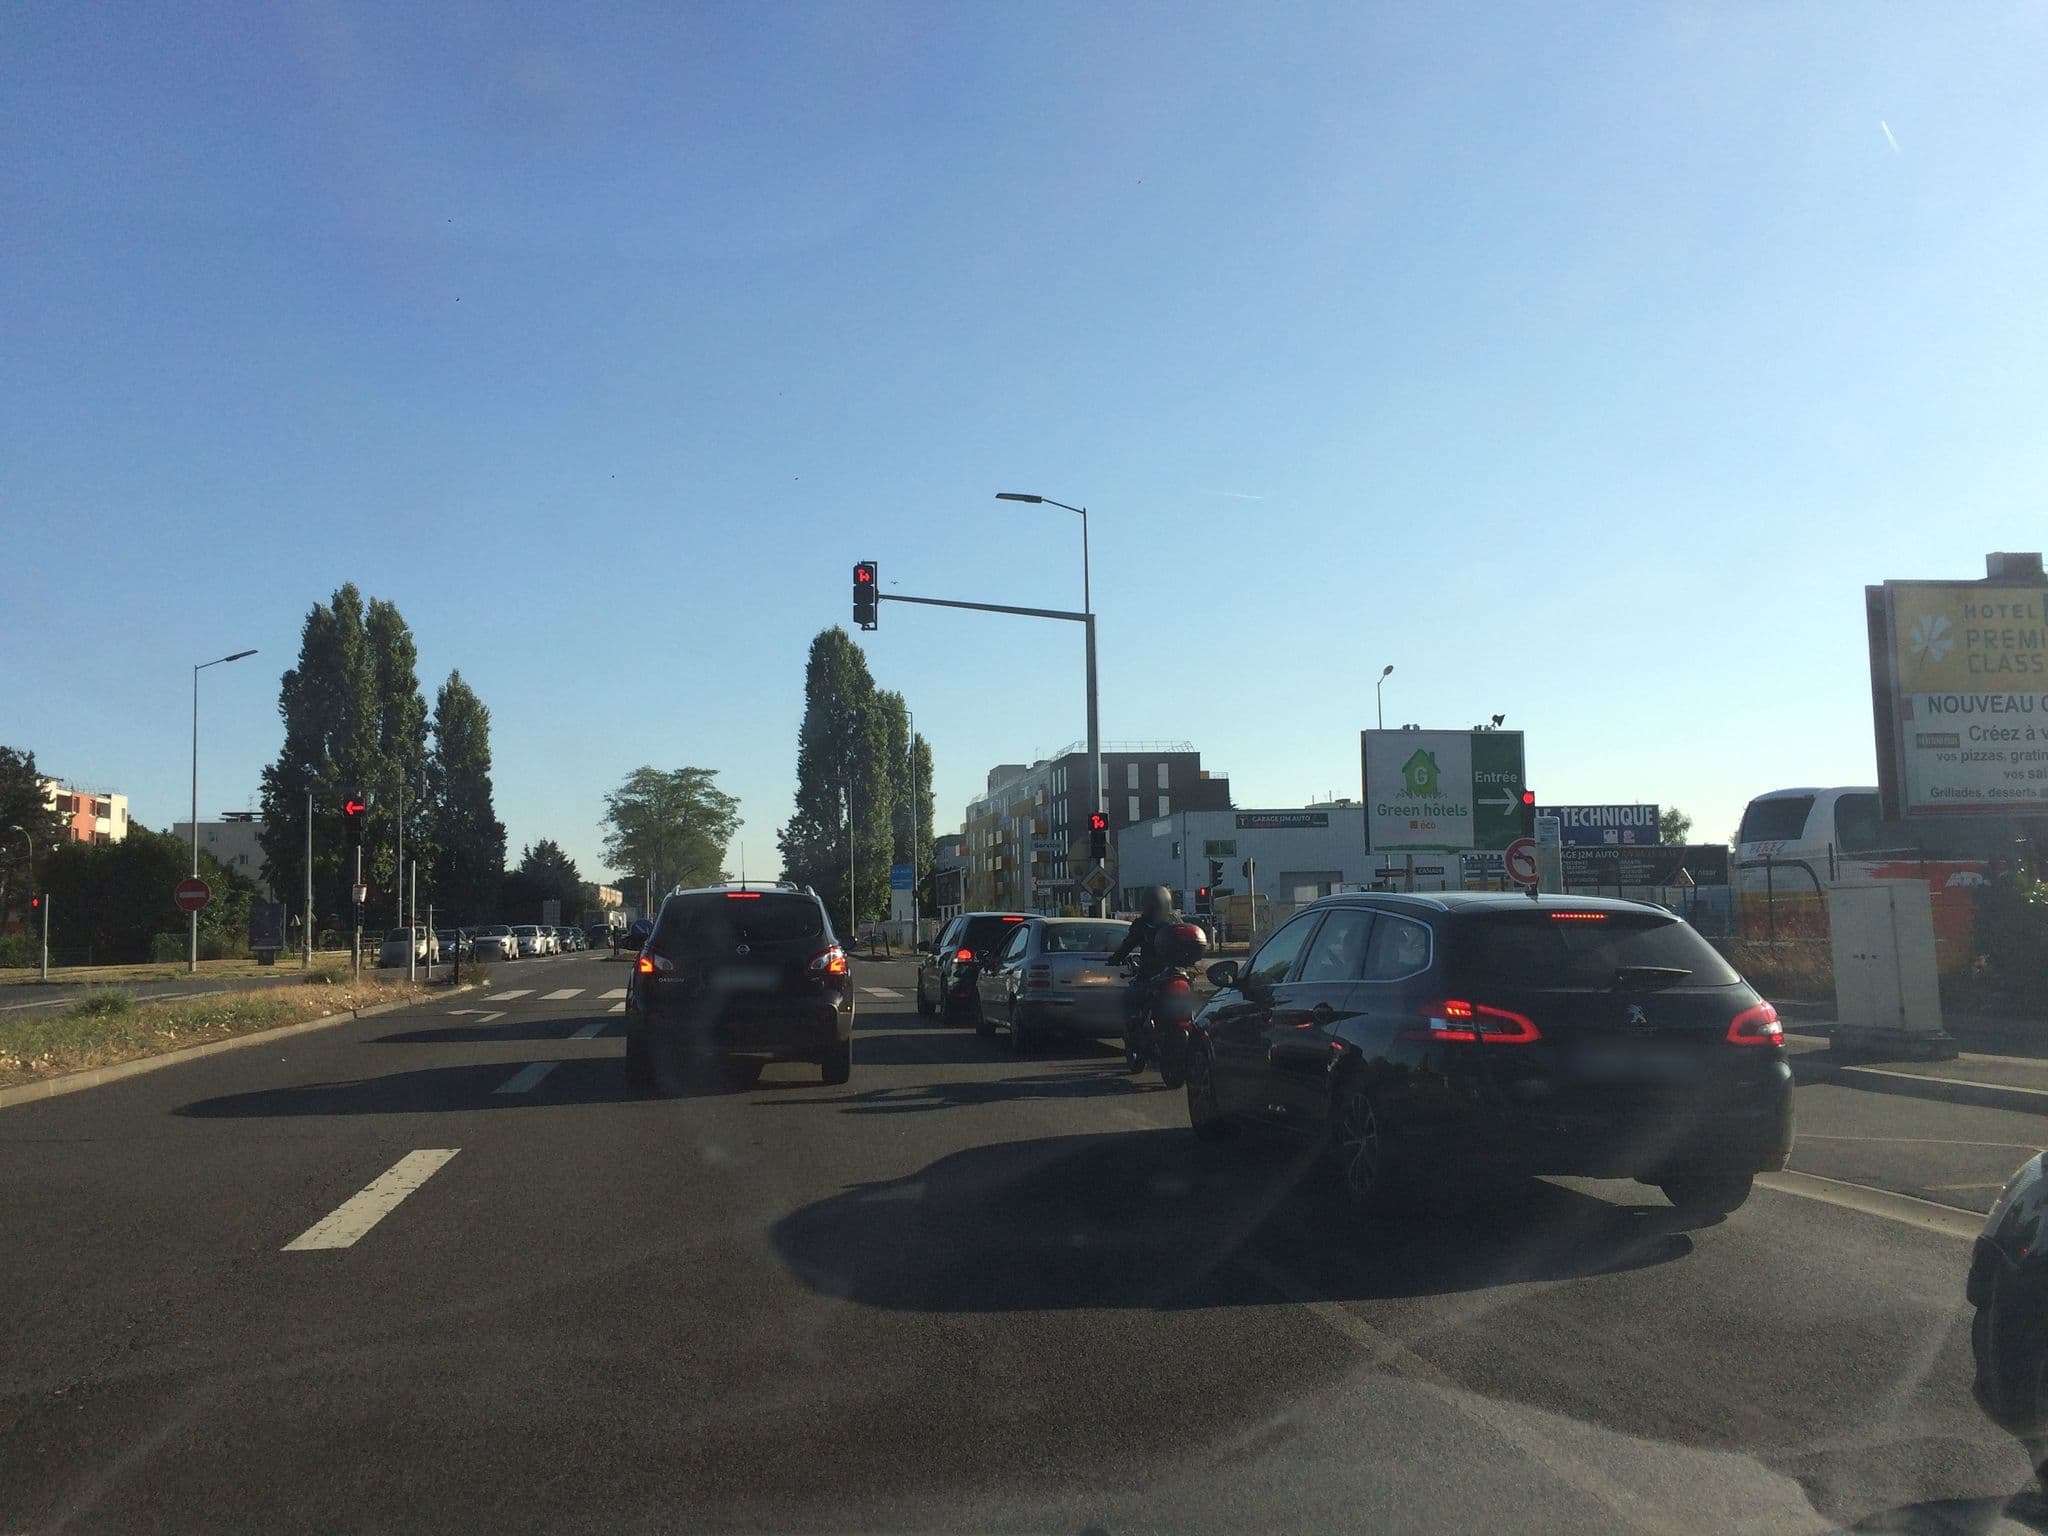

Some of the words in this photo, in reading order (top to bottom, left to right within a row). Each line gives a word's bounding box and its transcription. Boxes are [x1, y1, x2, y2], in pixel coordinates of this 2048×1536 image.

[1964, 604, 2036, 619] HOTEL
[1927, 695, 2034, 713] NOUVEAU
[1968, 725, 2020, 741] Créez
[2025, 725, 2036, 741] à
[1936, 753, 1957, 762] vos
[1474, 771, 1518, 783] Entrée
[1377, 804, 1420, 817] Green
[1424, 803, 1468, 817] hôtels
[1560, 807, 1654, 827] TECHNIQUE
[1595, 850, 1619, 859] AUTO
